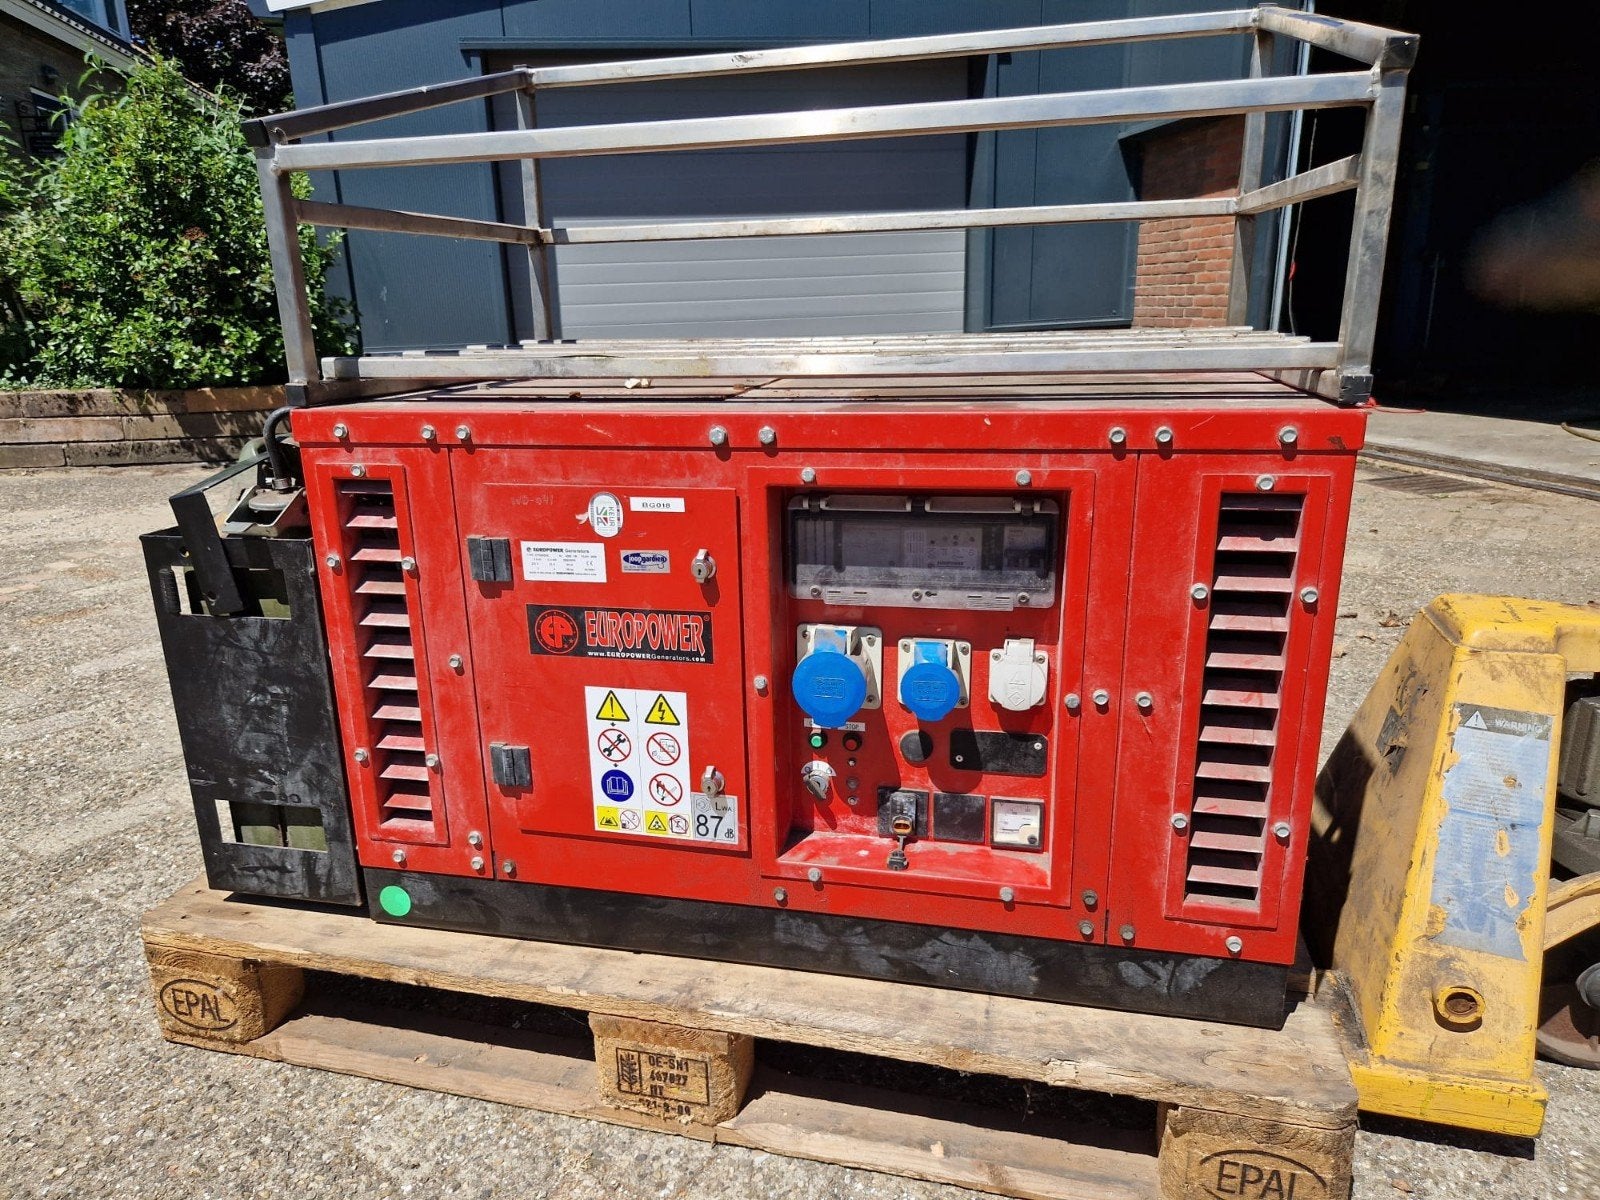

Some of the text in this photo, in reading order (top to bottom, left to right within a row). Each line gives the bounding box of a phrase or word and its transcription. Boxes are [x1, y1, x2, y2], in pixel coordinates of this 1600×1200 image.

[584, 610, 706, 657] EUROPOWER
[696, 813, 724, 839] 87
[171, 988, 230, 1023] EPAL
